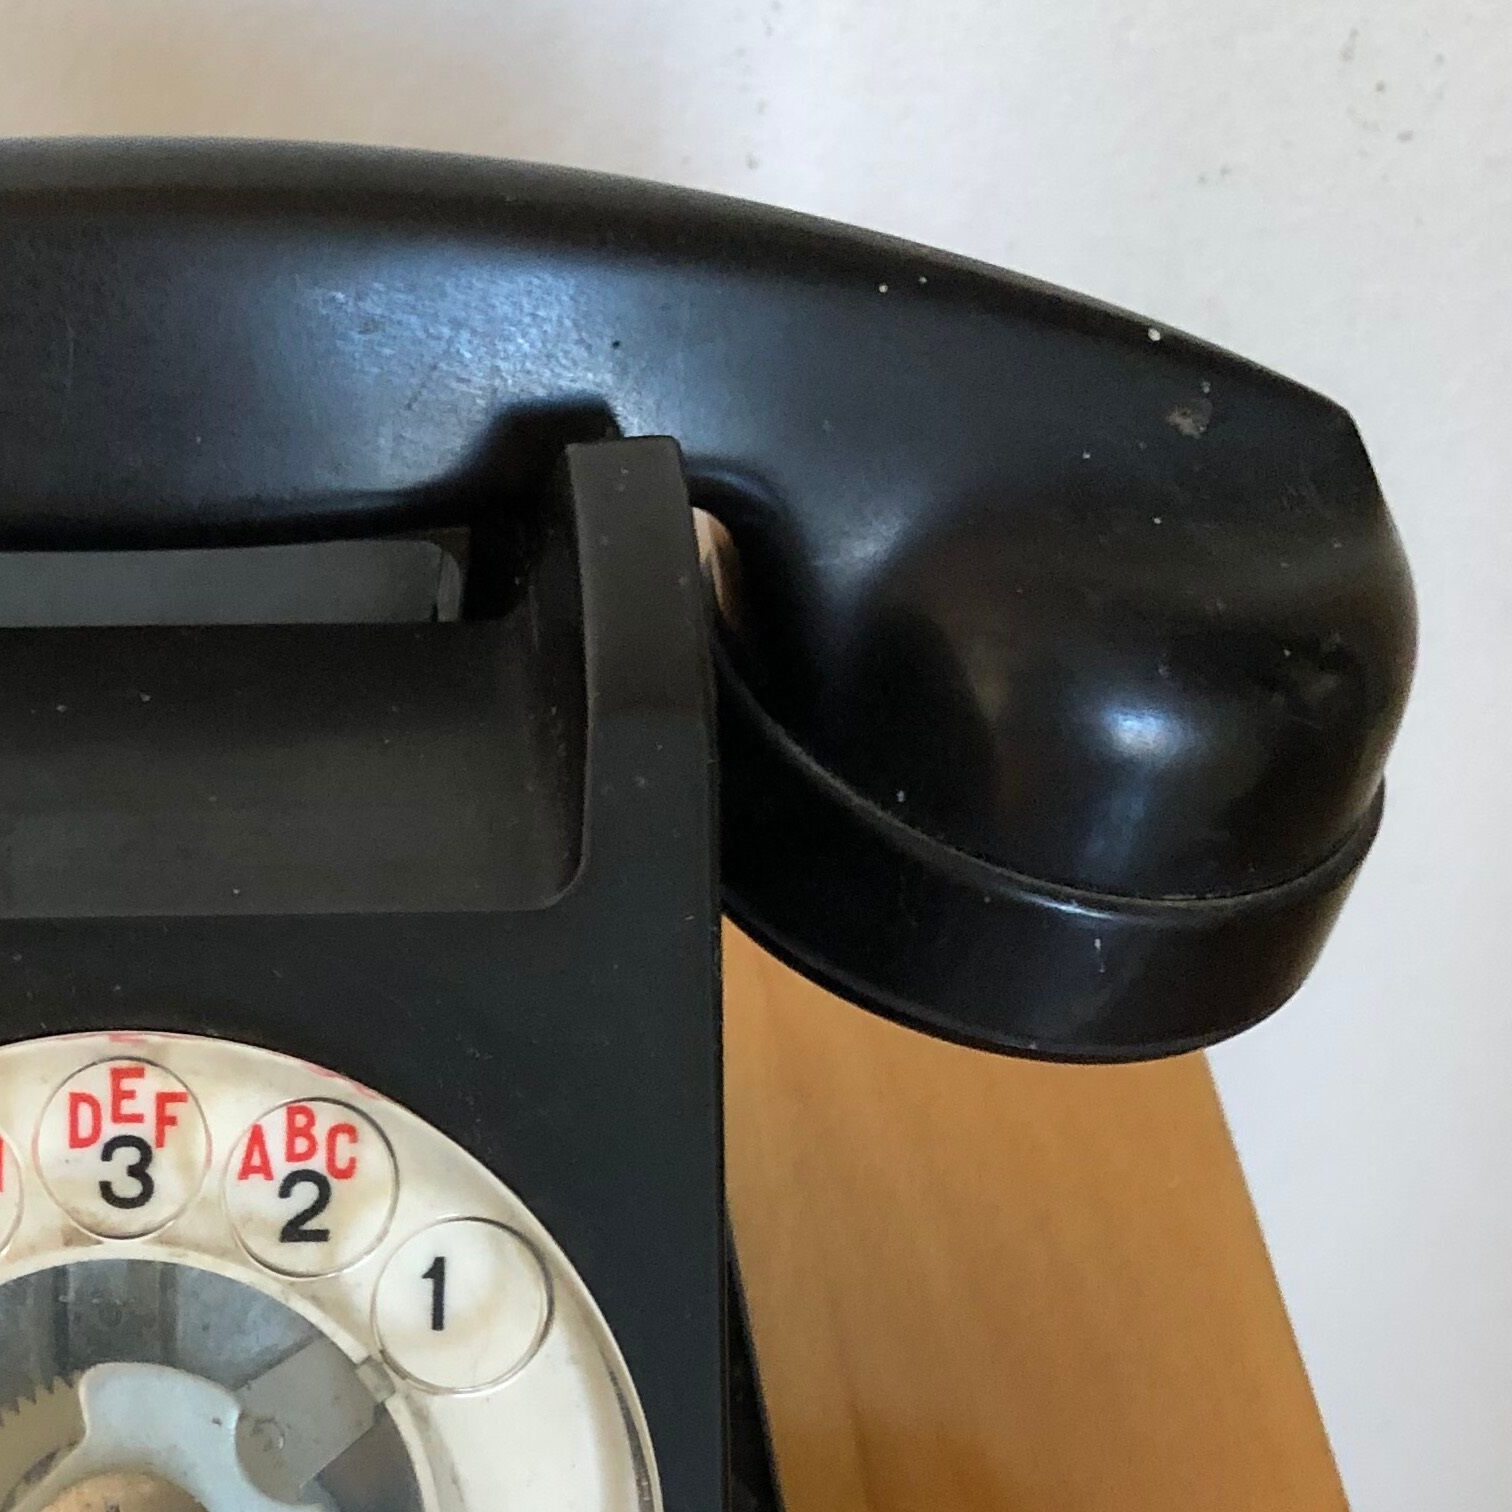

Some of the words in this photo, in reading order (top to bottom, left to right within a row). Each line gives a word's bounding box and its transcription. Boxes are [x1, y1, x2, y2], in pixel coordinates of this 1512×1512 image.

[68, 1066, 188, 1149] DEF
[236, 1104, 360, 1181] ABC
[99, 1135, 156, 1209] 3
[277, 1168, 332, 1243] 2
[420, 1255, 446, 1332] 1
